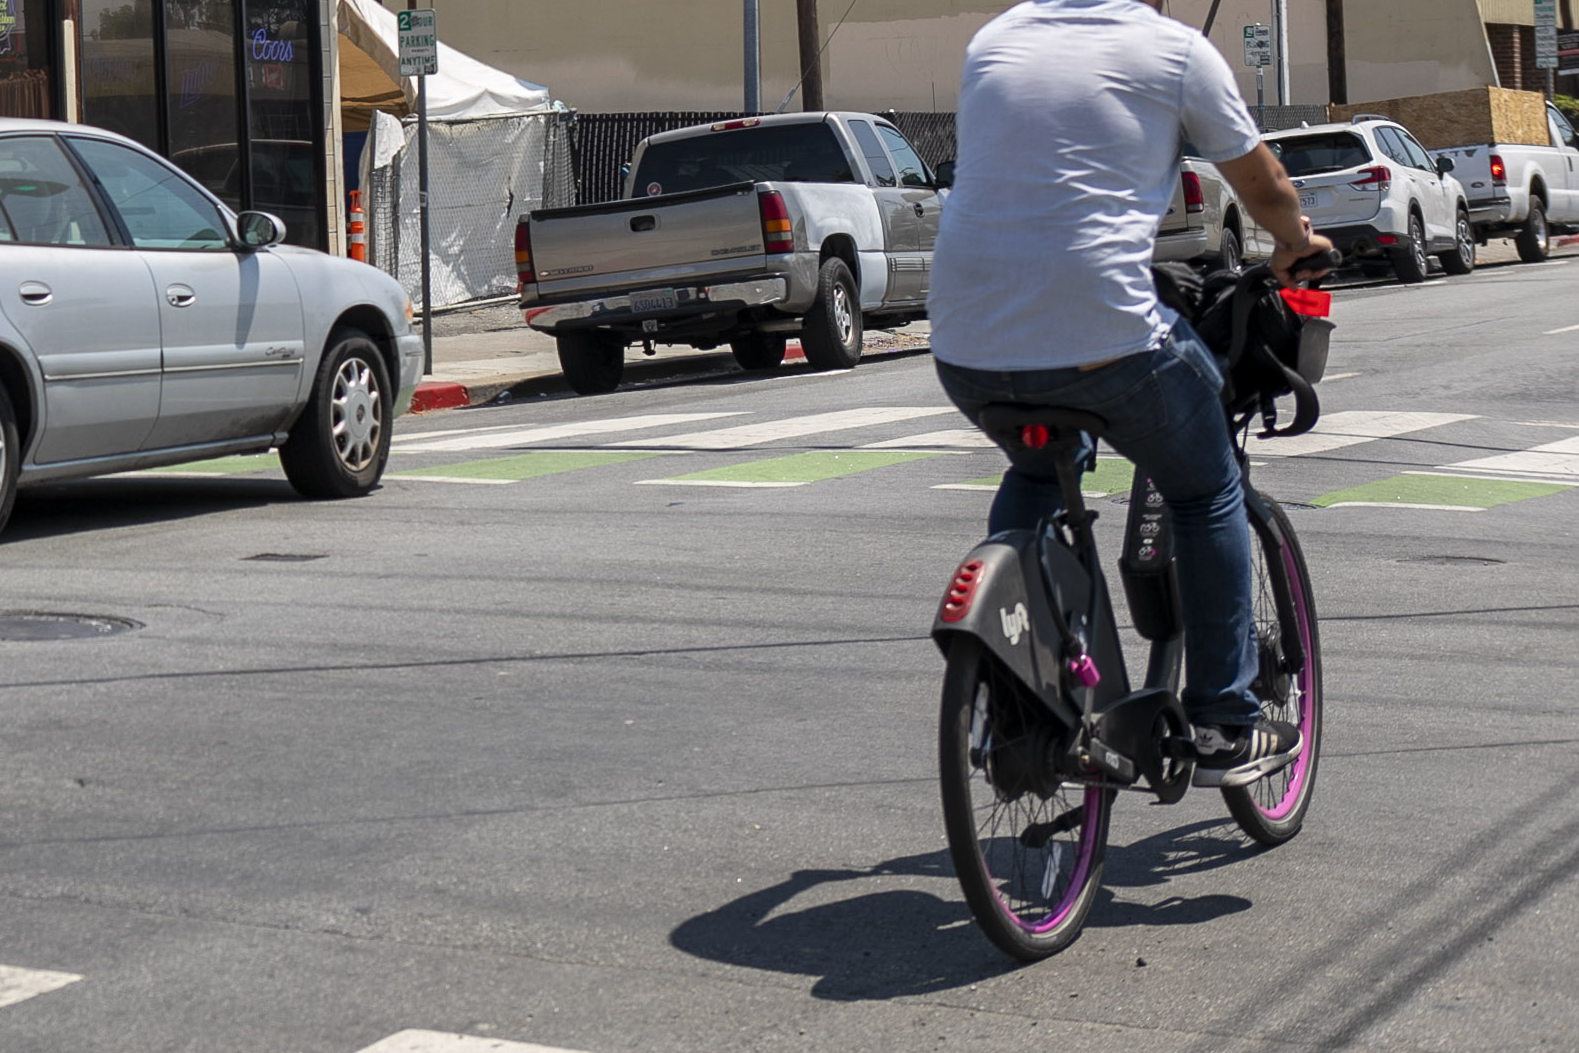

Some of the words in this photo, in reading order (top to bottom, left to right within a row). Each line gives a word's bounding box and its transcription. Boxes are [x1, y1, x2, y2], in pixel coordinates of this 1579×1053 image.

[400, 14, 409, 29] 2
[251, 28, 293, 62] Coors
[400, 35, 435, 48] PARKING
[401, 56, 436, 66] ANYTIME
